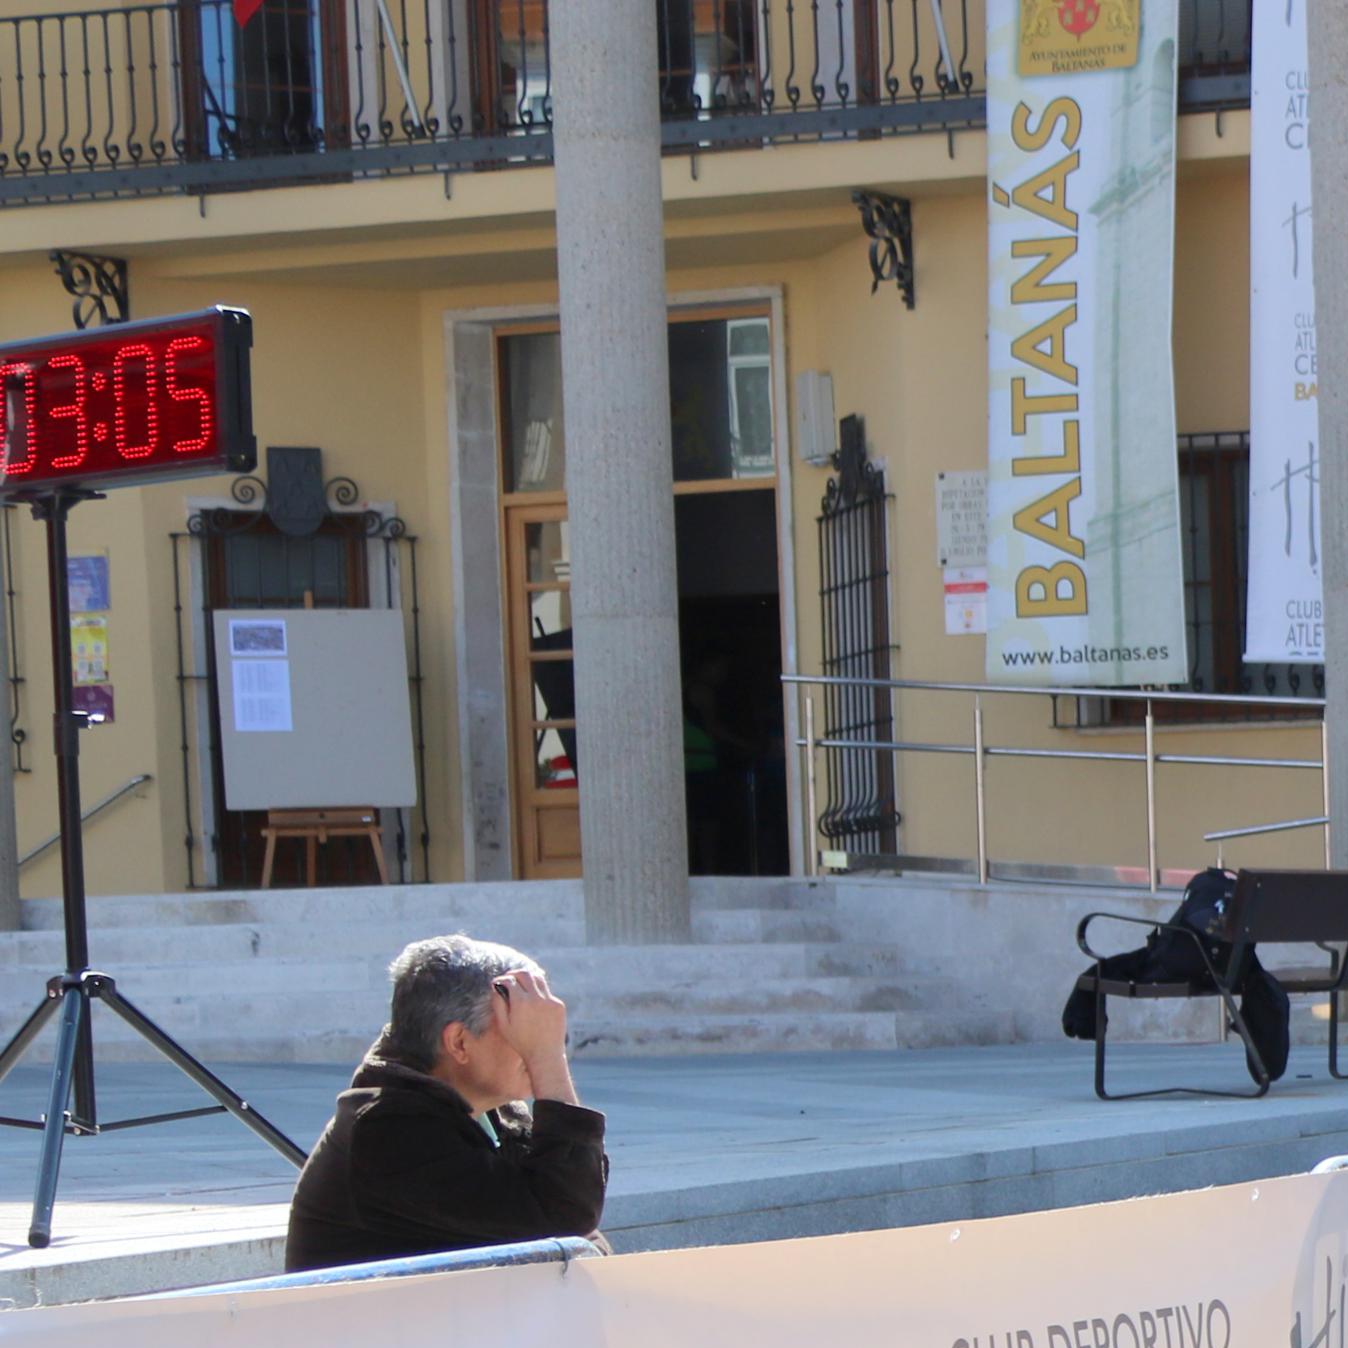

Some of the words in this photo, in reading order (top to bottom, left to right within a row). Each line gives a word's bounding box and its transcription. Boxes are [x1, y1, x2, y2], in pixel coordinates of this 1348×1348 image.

[1030, 45, 1111, 61] AYUNTAMIENTO
[1113, 43, 1126, 54] DE
[993, 95, 1088, 618] BALTANÁS
[0, 336, 211, 475] 03:05
[1002, 645, 1169, 666] www.baltanas.es
